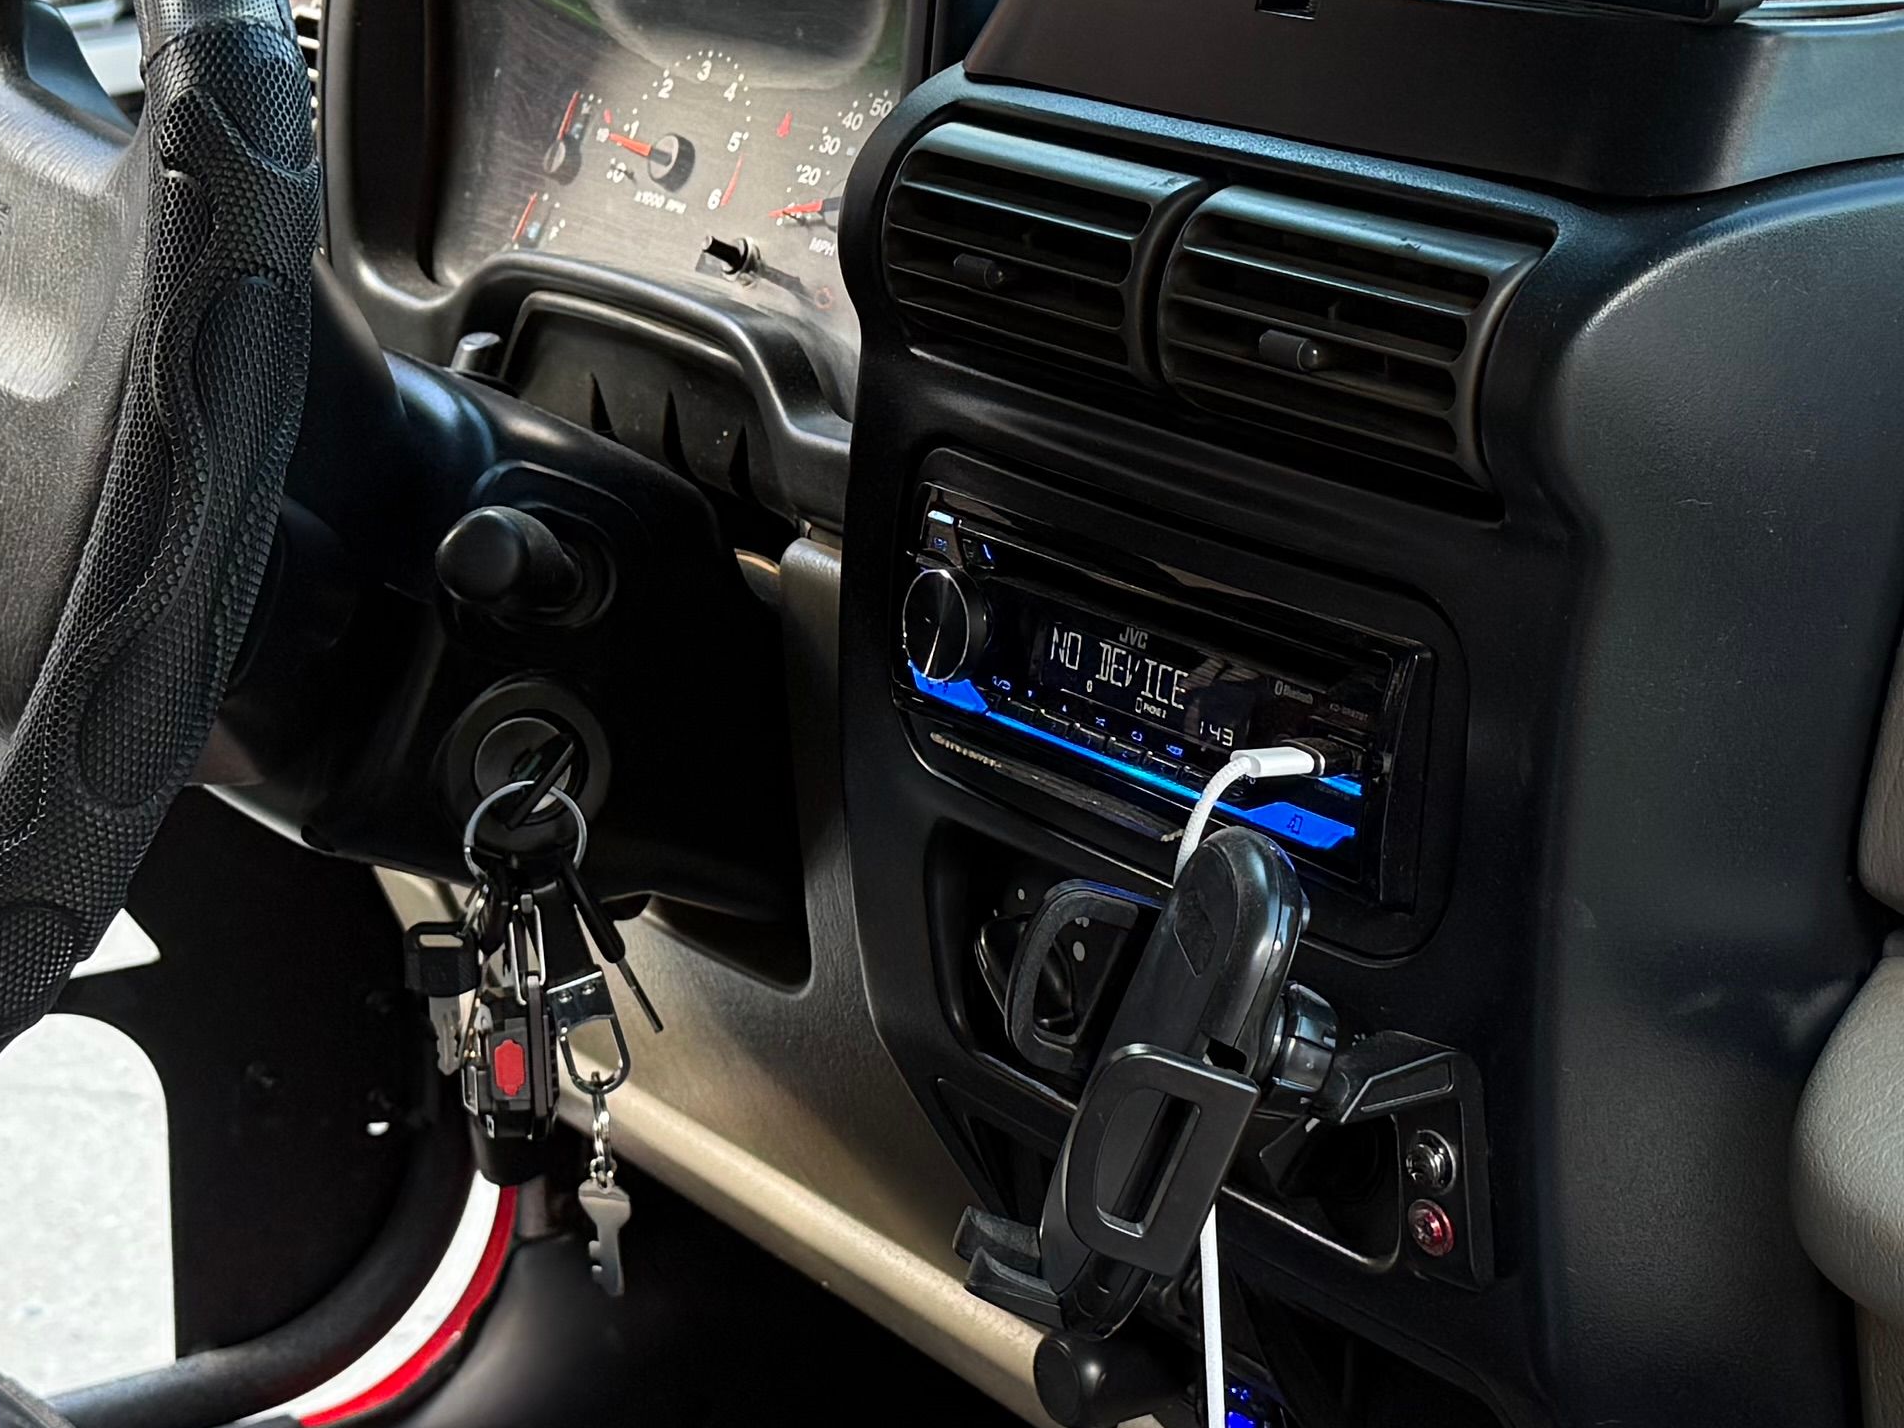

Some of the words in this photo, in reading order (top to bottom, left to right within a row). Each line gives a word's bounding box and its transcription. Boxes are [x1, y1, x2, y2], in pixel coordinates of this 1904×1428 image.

[697, 59, 712, 80] 3
[658, 78, 674, 99] 2
[723, 82, 738, 102] 4
[869, 98, 894, 119] 50
[842, 111, 864, 131] 40
[727, 132, 742, 152] 5
[819, 134, 841, 155] 30
[798, 164, 822, 186] 20
[707, 188, 723, 210] 6
[808, 236, 836, 256] MPH
[1119, 625, 1149, 650] JVC
[1050, 626, 1082, 671] NO
[1095, 642, 1190, 710] DEVICE
